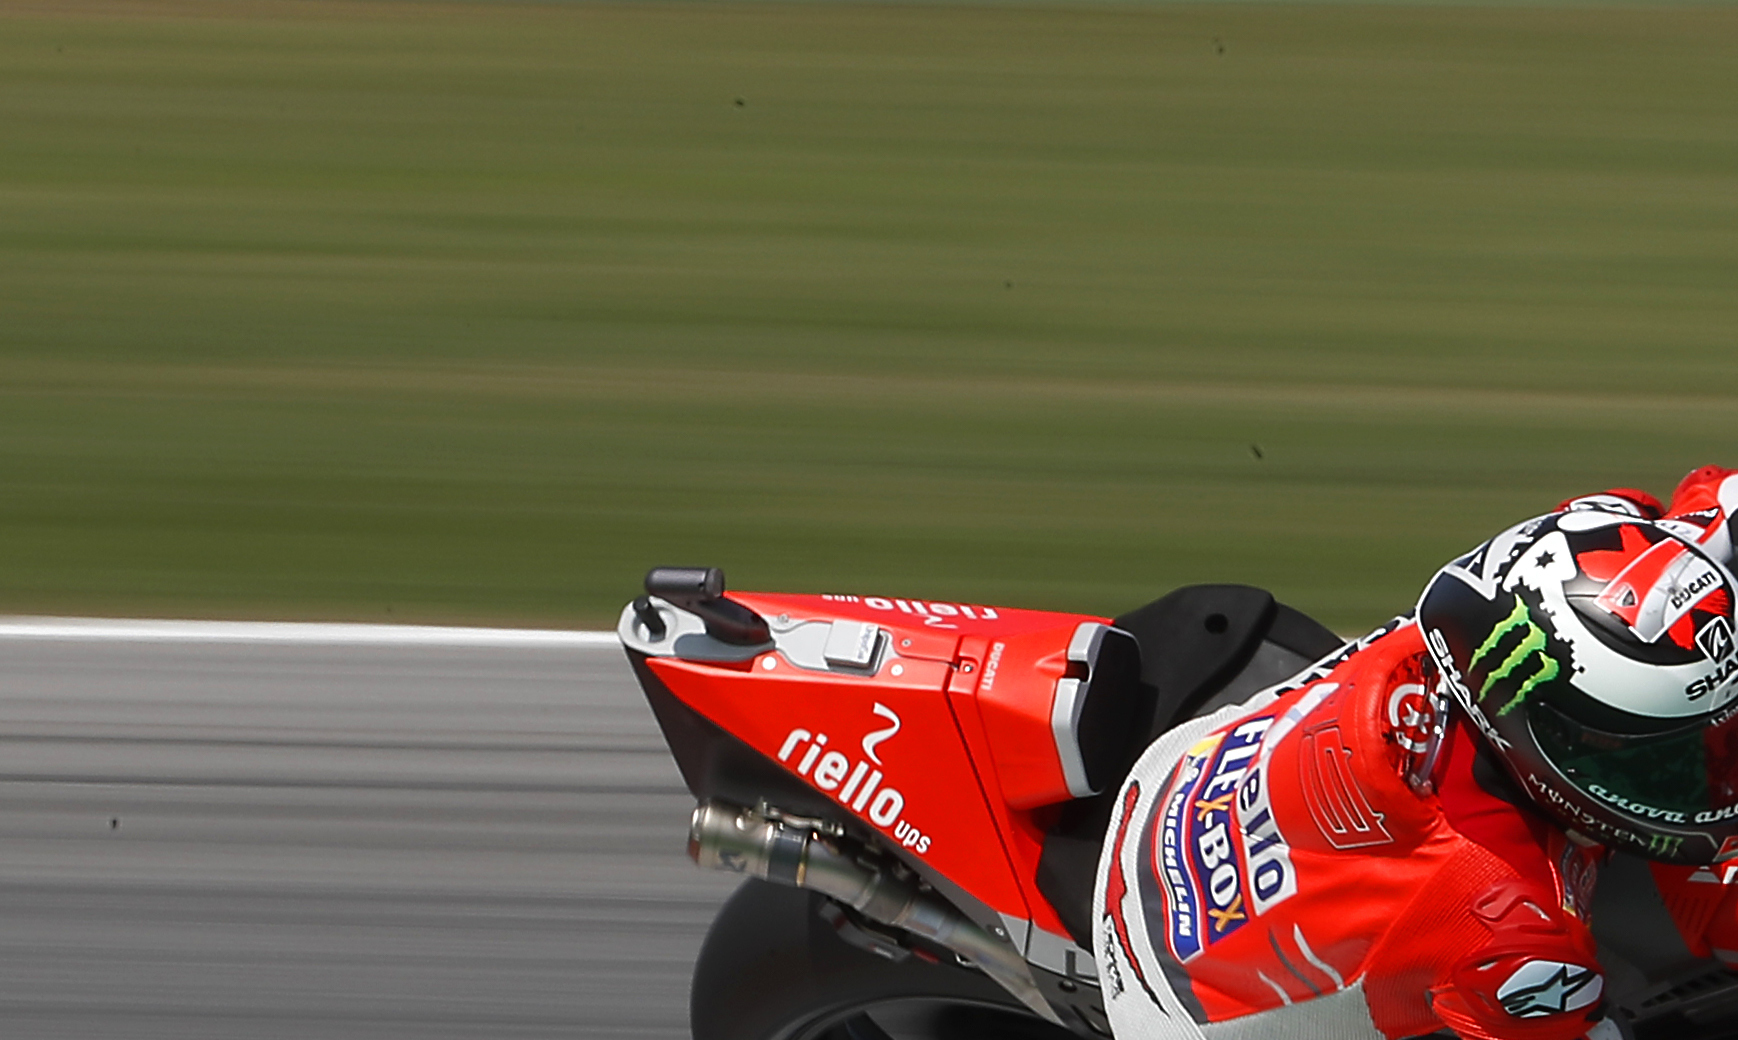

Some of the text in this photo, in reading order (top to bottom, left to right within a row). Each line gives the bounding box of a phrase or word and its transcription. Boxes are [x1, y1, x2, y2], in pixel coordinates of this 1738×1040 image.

[864, 597, 999, 620] riello
[1669, 569, 1720, 611] DUCATI
[981, 641, 1006, 691] DUCATI
[1427, 627, 1514, 753] SHARK
[777, 727, 931, 854] riello ups
[1195, 716, 1277, 933] FLEX-BOX
[1587, 783, 1686, 824] anova
[1163, 793, 1192, 938] MICHELIN
